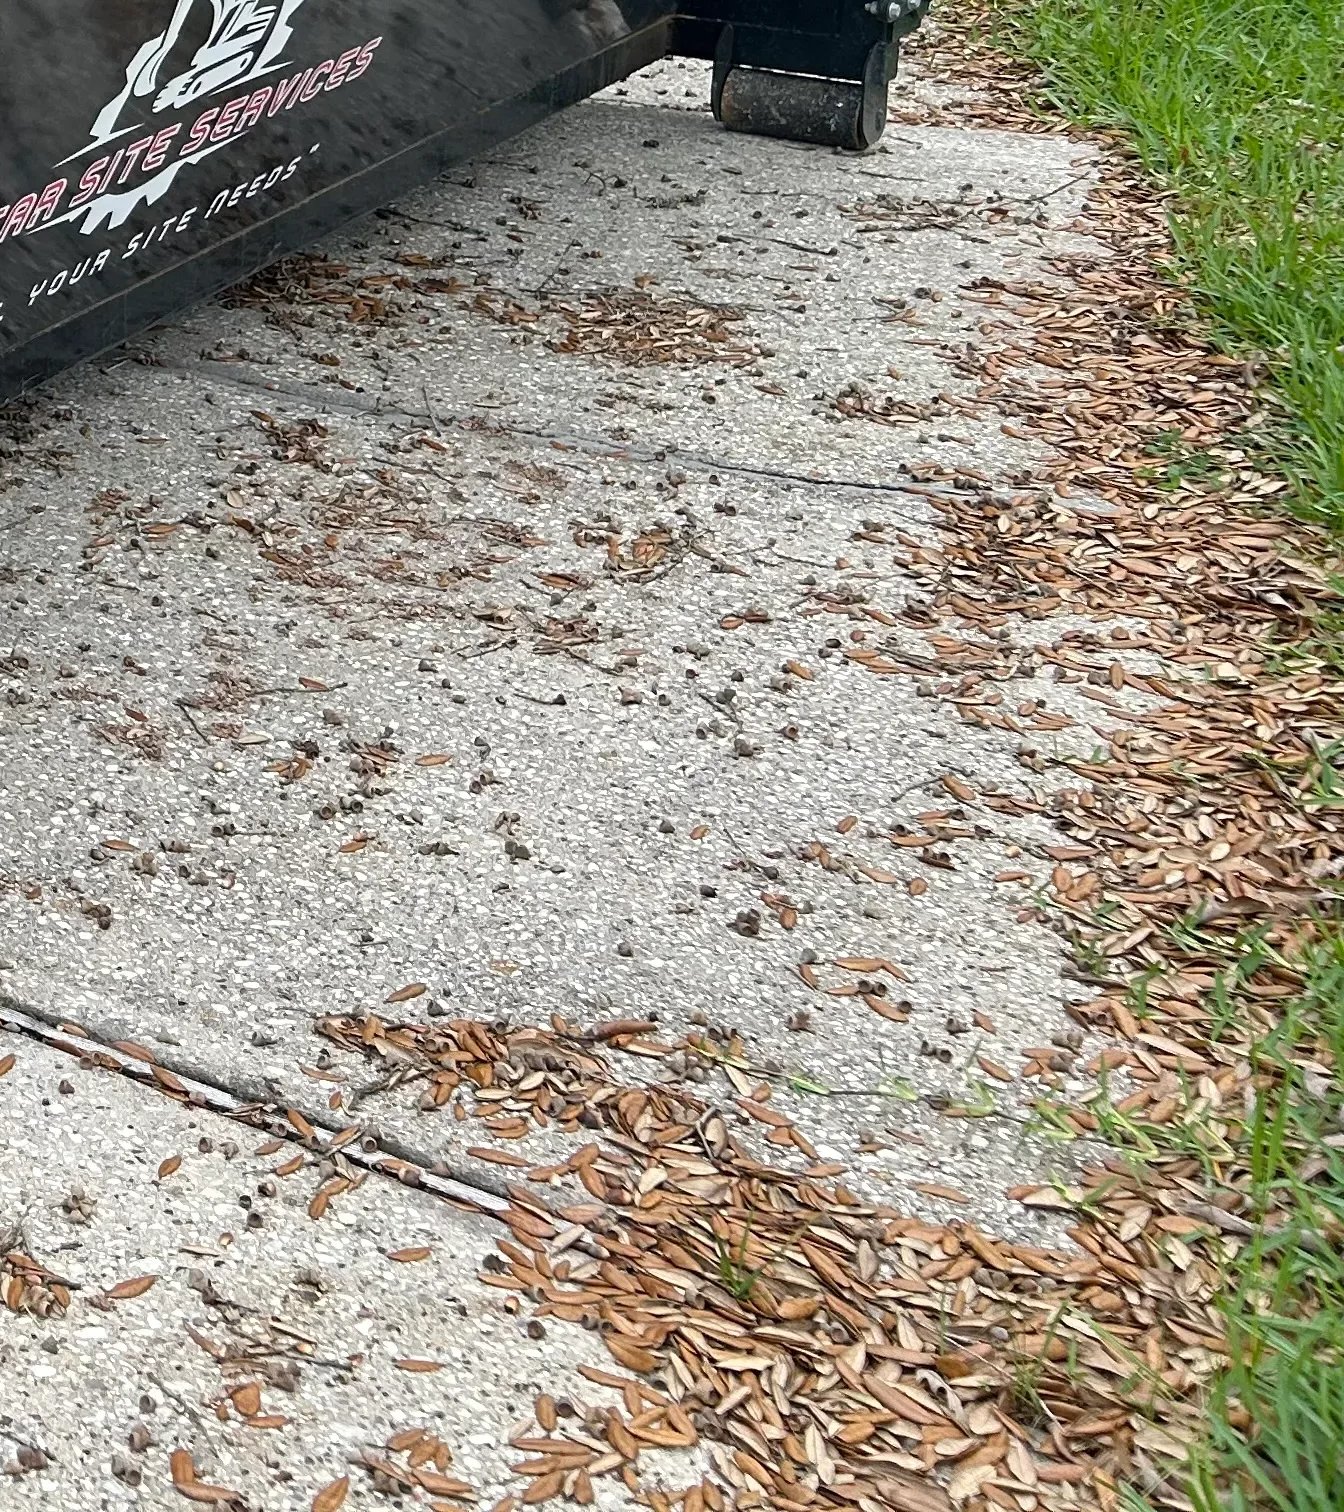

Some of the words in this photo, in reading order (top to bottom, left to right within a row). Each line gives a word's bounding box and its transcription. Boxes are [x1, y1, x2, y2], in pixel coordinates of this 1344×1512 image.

[68, 122, 183, 208] SITE
[179, 36, 383, 157] SERVICES
[27, 248, 111, 307] YOUR
[121, 206, 198, 260] SITE
